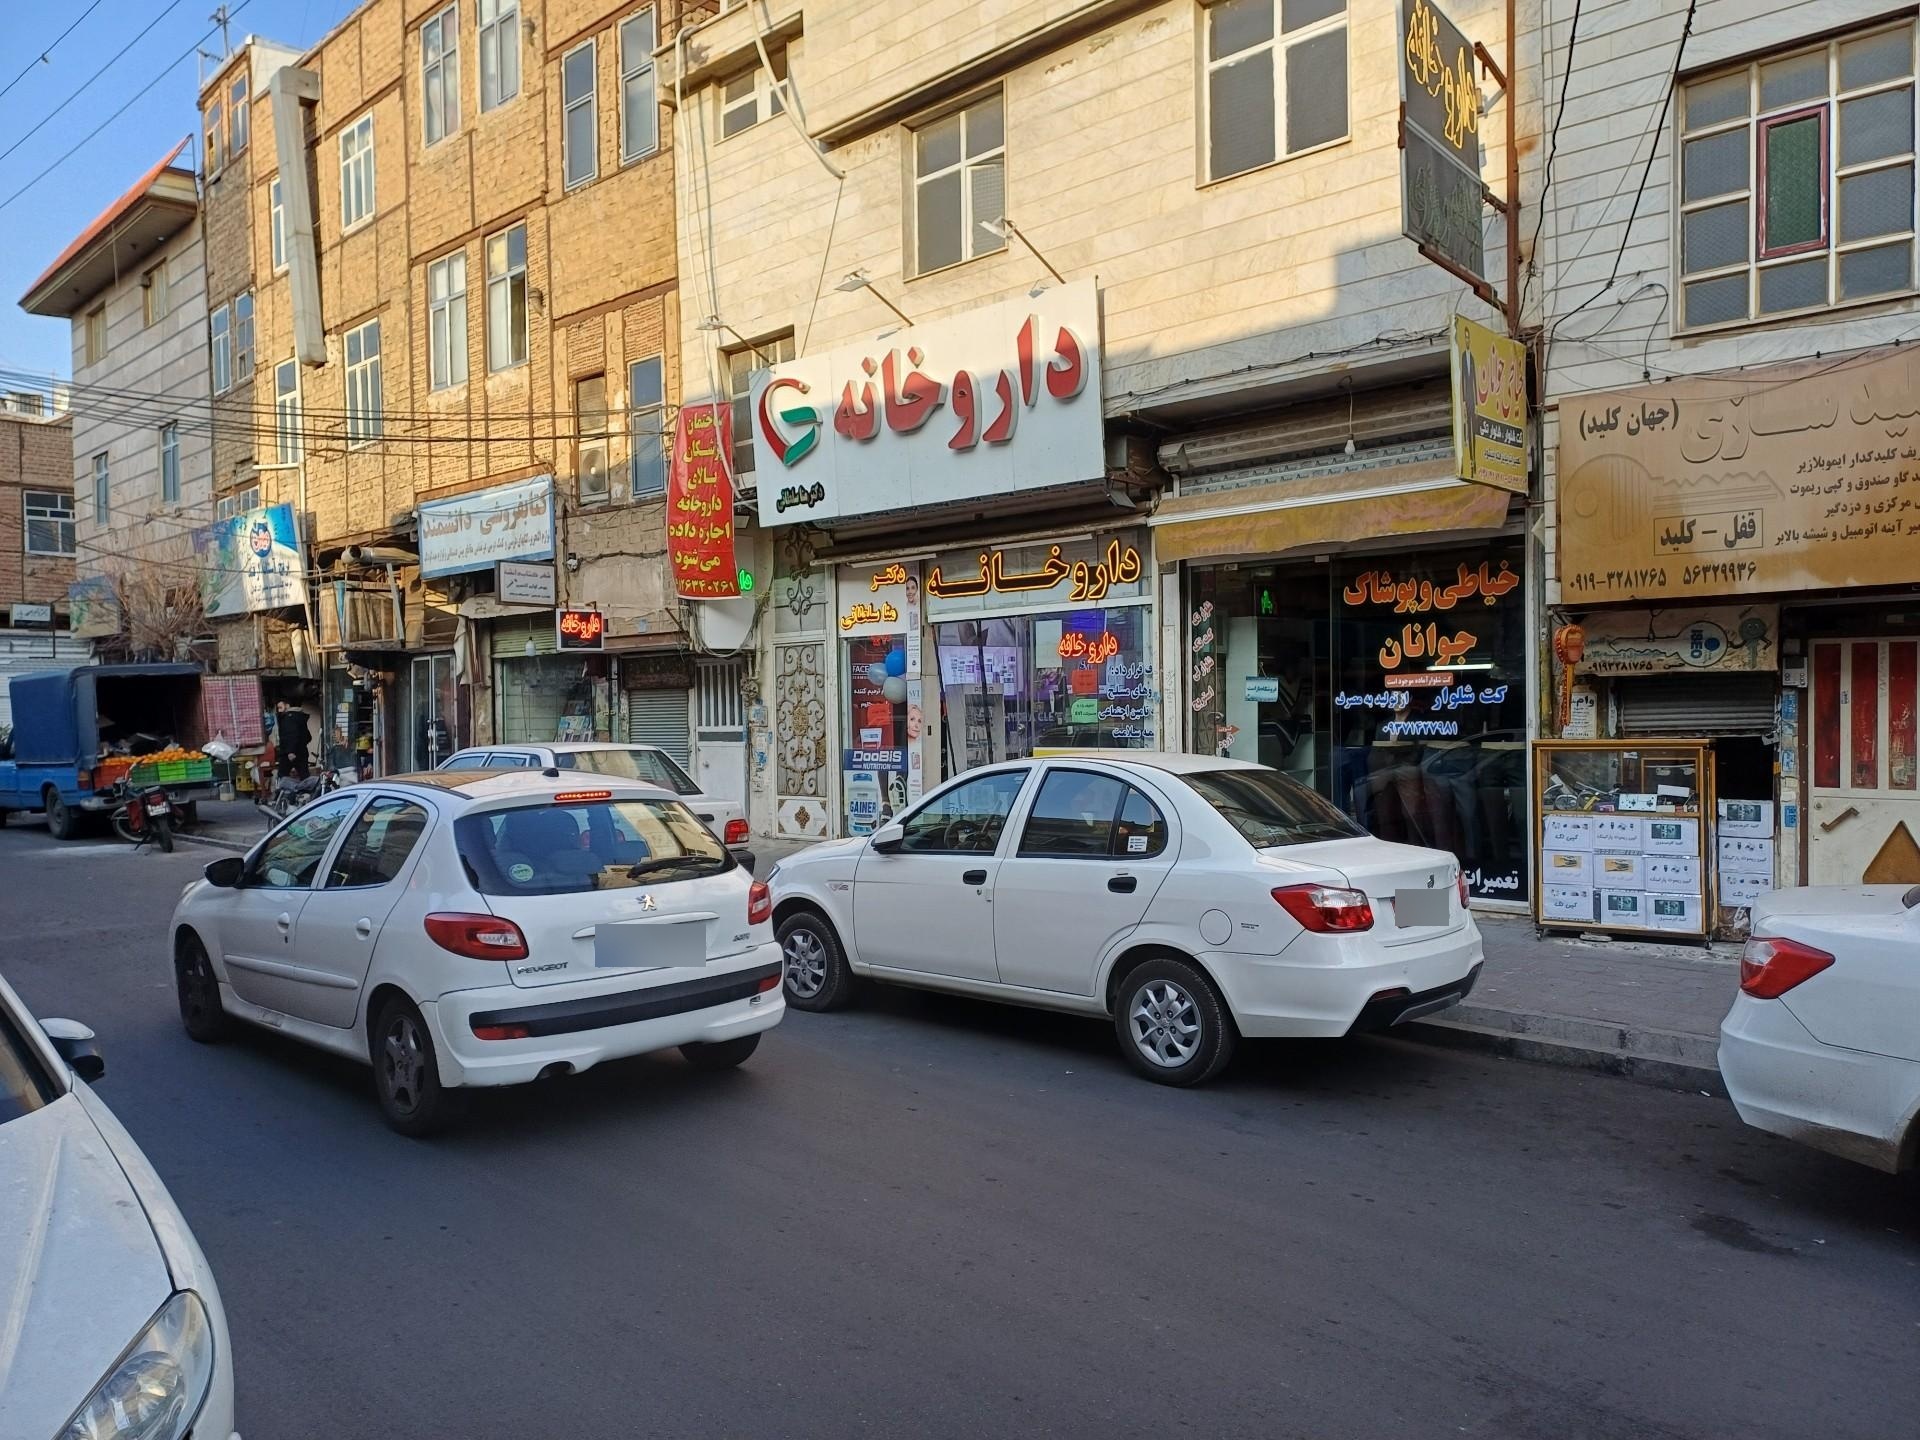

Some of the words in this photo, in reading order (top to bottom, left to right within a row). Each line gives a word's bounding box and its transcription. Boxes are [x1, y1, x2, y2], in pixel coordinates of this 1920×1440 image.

[833, 313, 1088, 452] داروخانه
[687, 465, 718, 490] بالای
[479, 490, 547, 535] کتابفروشی
[676, 494, 723, 517] داروخانه
[669, 520, 697, 538] داده
[698, 521, 731, 545] اجاره
[1660, 518, 1697, 552] کلید
[1724, 511, 1757, 549] قفل
[674, 547, 699, 570] شود
[700, 555, 721, 572] می
[926, 538, 1141, 601] داروخانه
[870, 563, 906, 592] دکتر
[1343, 570, 1417, 613] پوشاک
[1434, 560, 1520, 609] خیاطی
[1417, 580, 1433, 612] و
[560, 613, 601, 639] داروخانه
[840, 602, 881, 630] سلطانی
[1058, 631, 1118, 663] داروخانه
[1379, 622, 1477, 669] جوانان
[1107, 685, 1130, 701] مسلح
[1431, 683, 1476, 711] شلوار
[1479, 685, 1508, 705] کت
[1111, 724, 1142, 738] سلامت
[517, 961, 569, 975] PEUGEOT
